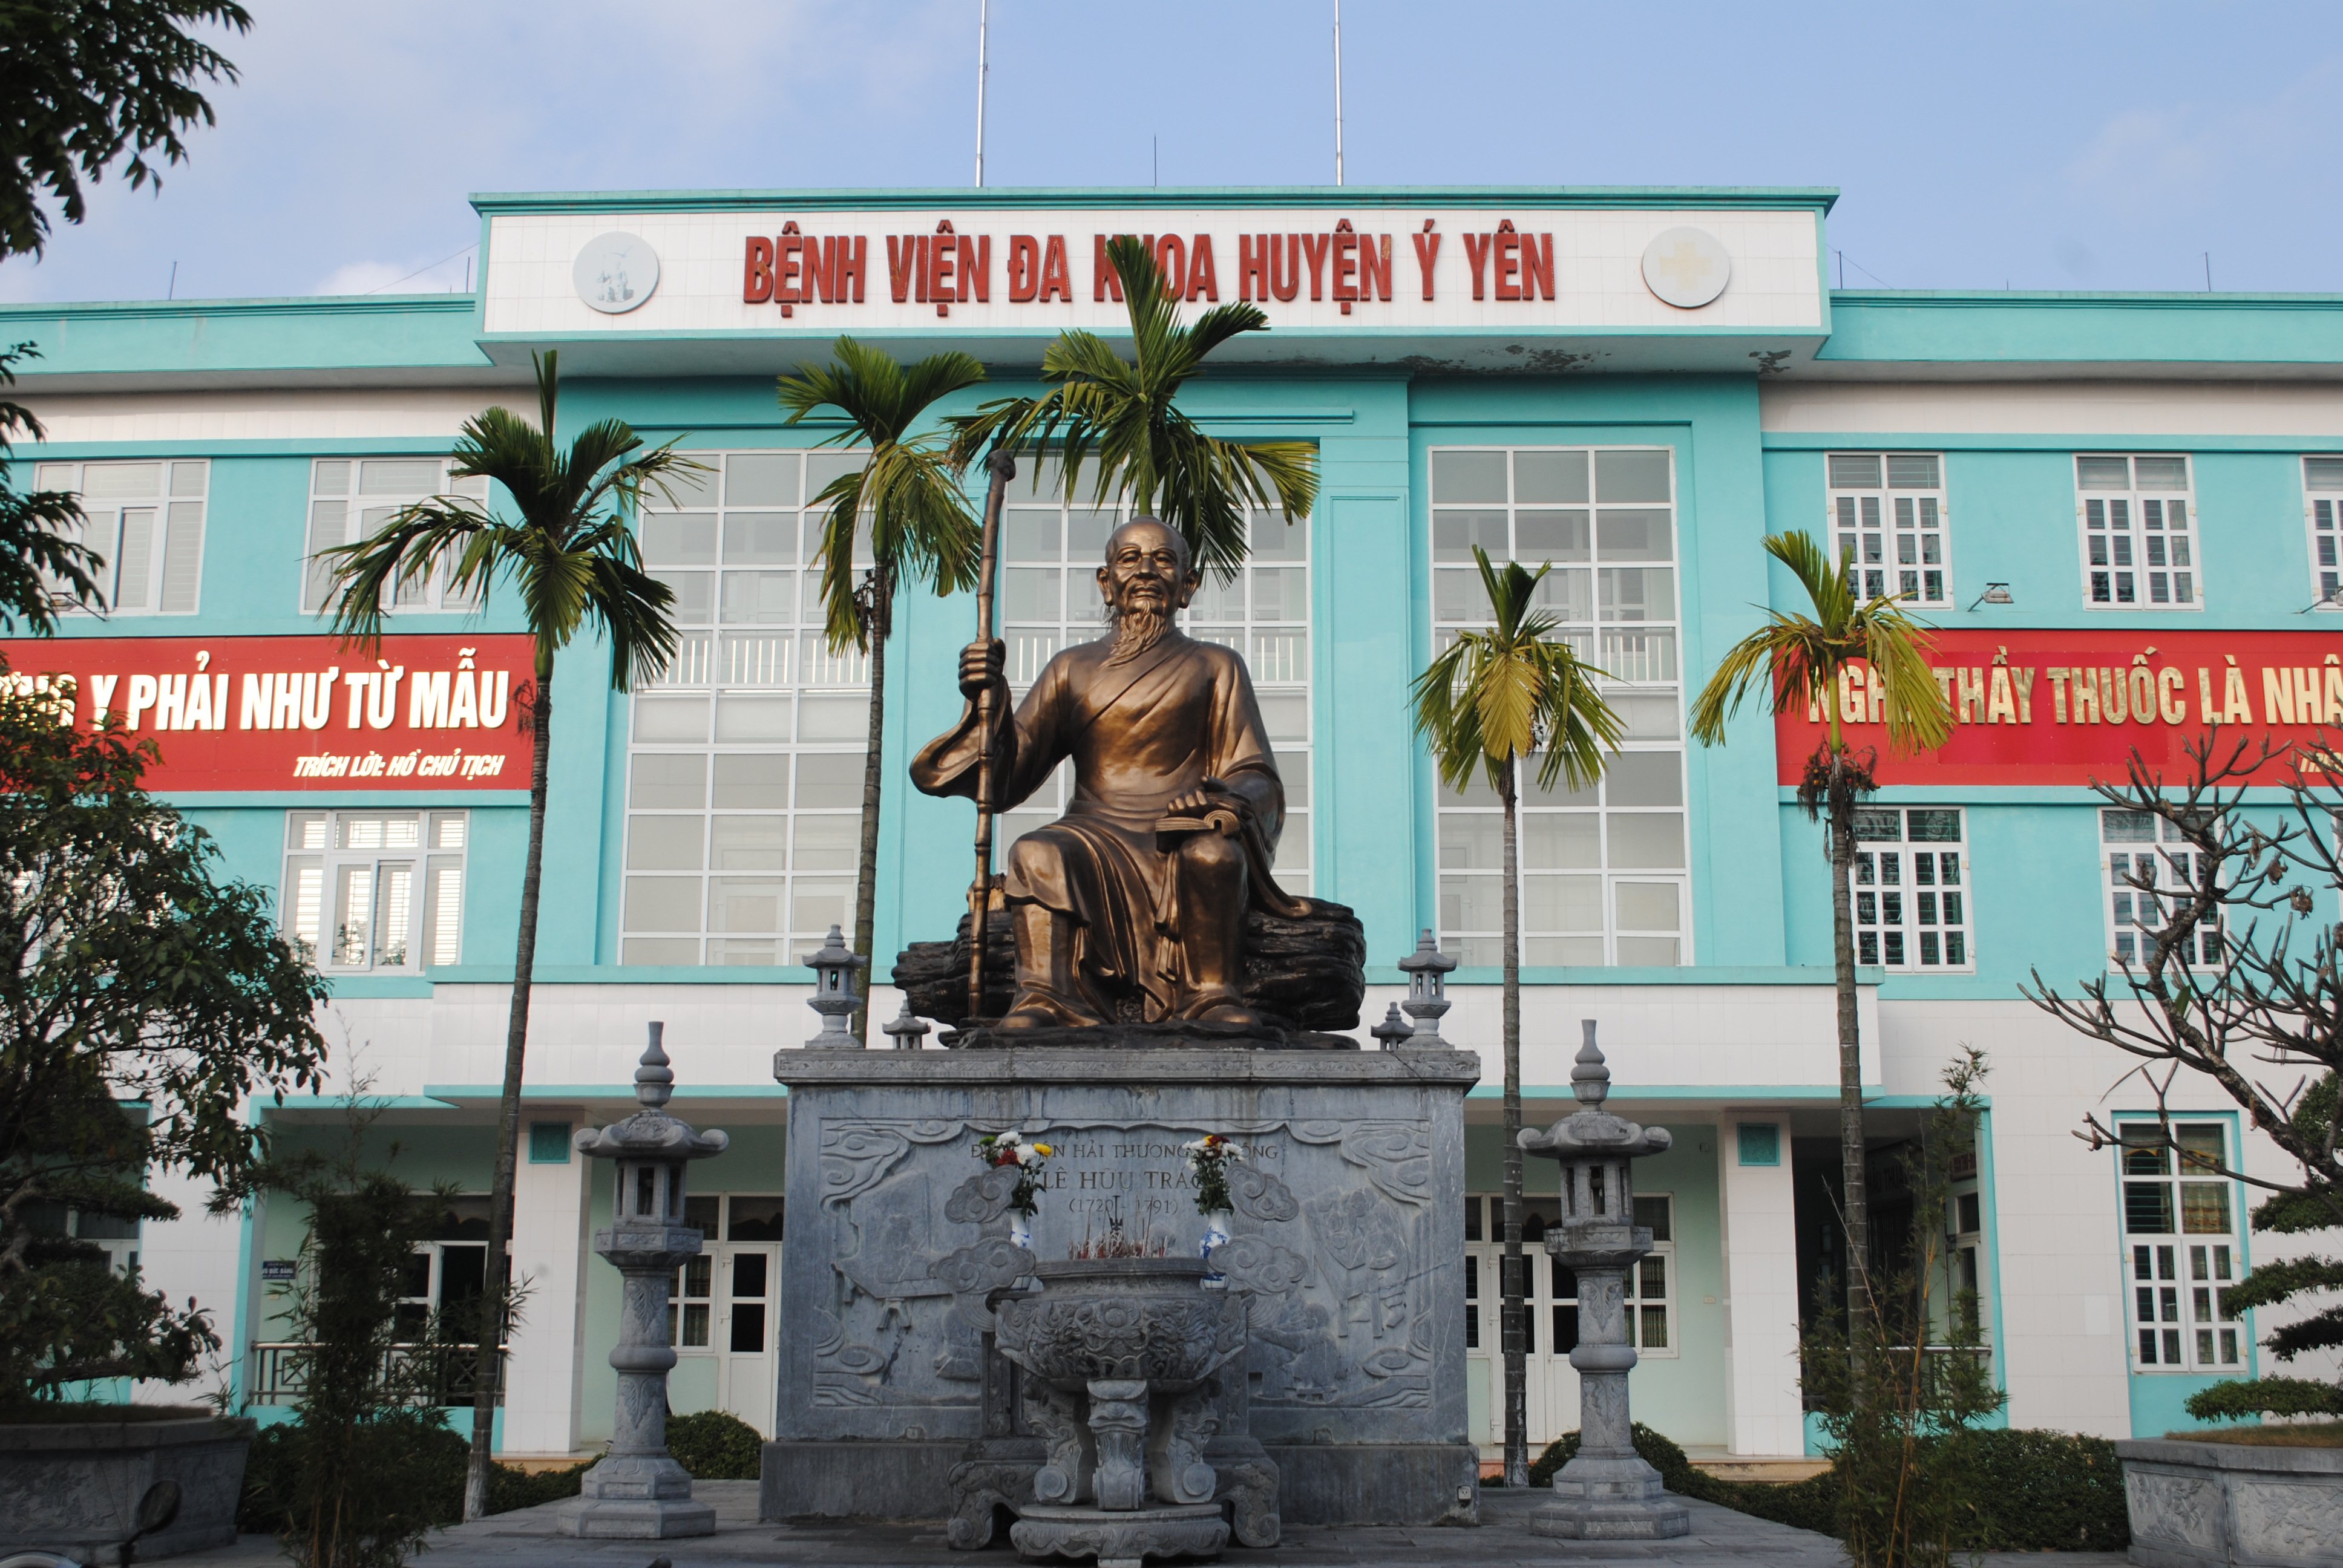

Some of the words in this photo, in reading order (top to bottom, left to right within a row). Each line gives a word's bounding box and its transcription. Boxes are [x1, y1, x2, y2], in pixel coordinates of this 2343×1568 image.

[743, 221, 867, 318] BỆNH
[886, 220, 990, 316] VIỆN
[1008, 234, 1072, 302] ĐA
[1094, 234, 1218, 302] KOA
[1239, 218, 1392, 315] HUYỆN
[1412, 219, 1441, 301] Ý
[1463, 219, 1555, 301] YÊN
[90, 675, 119, 731] Y
[125, 650, 229, 730] PHẢI
[240, 666, 339, 730] NHƯ
[345, 659, 404, 730] TỪ
[408, 647, 509, 728] MẪU
[1932, 645, 2036, 724] THẦY
[2046, 645, 2186, 725] THUỐC
[2198, 655, 2252, 724] LÀ
[293, 752, 350, 777] TRÍCH
[385, 748, 421, 776] HỒ
[418, 748, 461, 776] CHỦ
[460, 755, 505, 780] TỊCH
[1073, 1139, 1104, 1158] HẢI
[1043, 1166, 1067, 1189] LÊ
